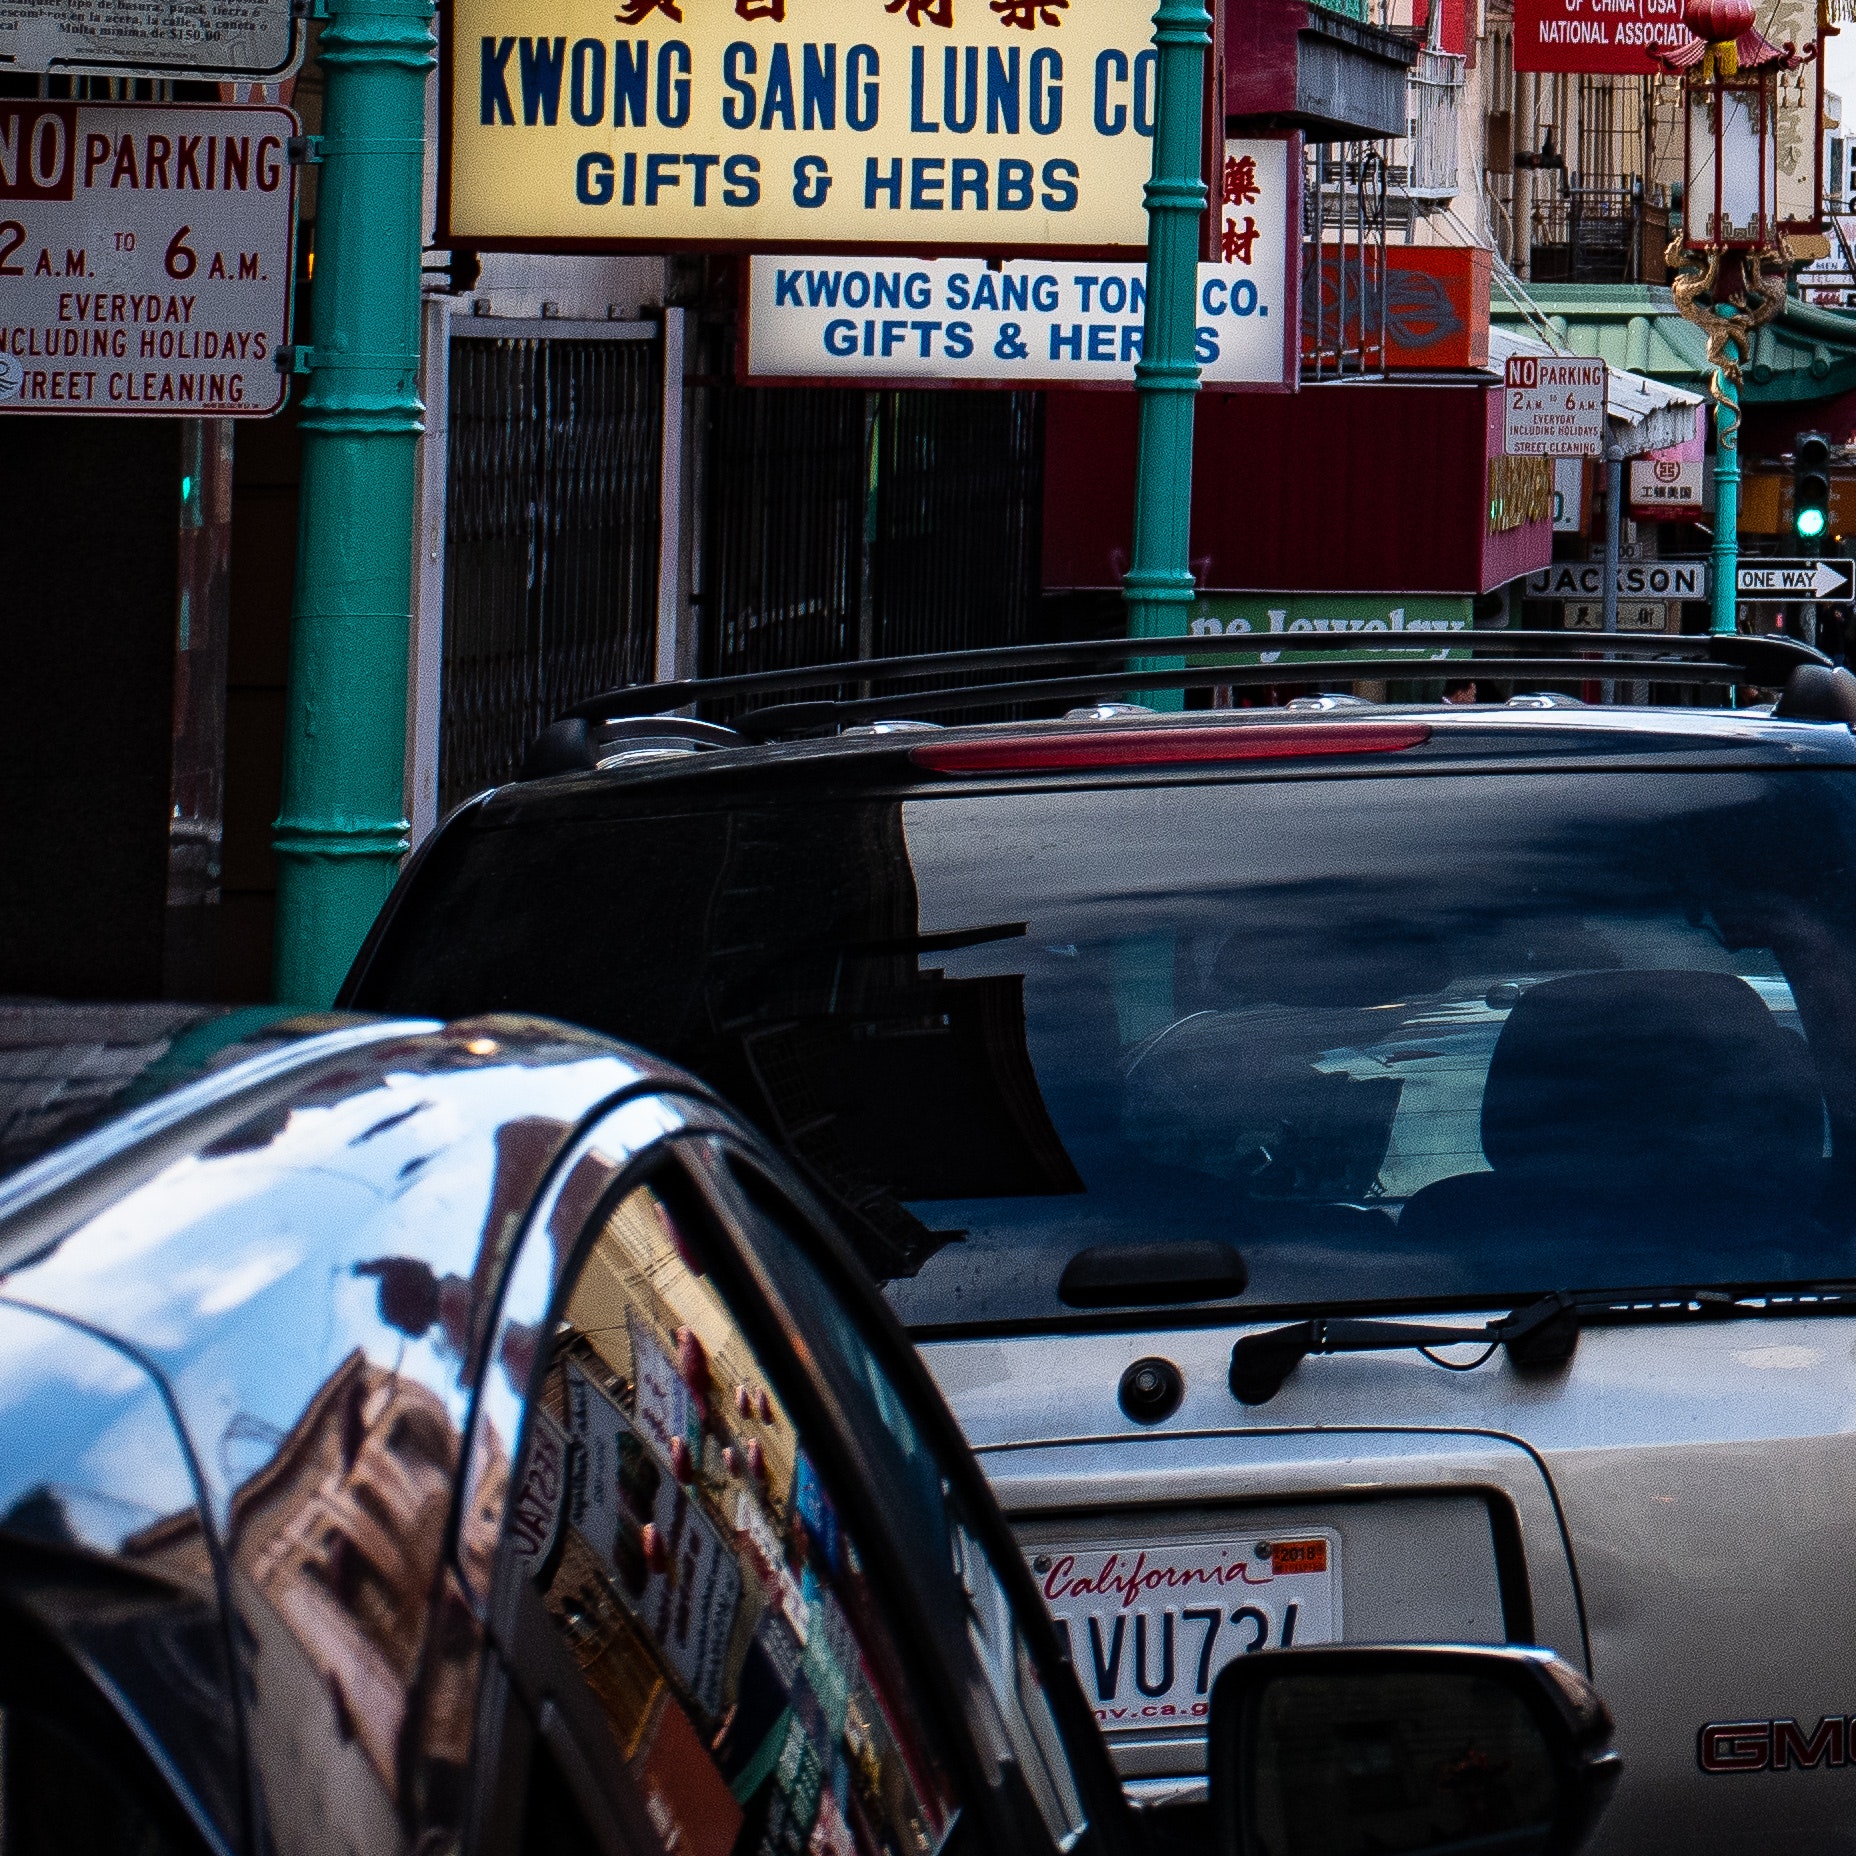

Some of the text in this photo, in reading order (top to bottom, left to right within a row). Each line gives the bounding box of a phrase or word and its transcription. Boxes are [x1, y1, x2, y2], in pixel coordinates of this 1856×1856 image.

[1540, 21, 1696, 45] NATIONAL ASSOCIATI
[481, 37, 691, 127] KWONG
[723, 43, 879, 130] SANG
[911, 46, 1062, 134] LUNG
[85, 135, 279, 190] PARKING
[577, 153, 1078, 210] GIFTS & HERBS
[36, 250, 95, 276] A.M.
[116, 233, 135, 251] TO
[165, 227, 196, 279] 6
[210, 253, 269, 279] A.M.
[776, 271, 1268, 316] KWONG SANG CO.
[59, 294, 193, 322] EVERYDAY
[140, 331, 266, 358] HOLIDAYS
[824, 320, 1219, 365] GIFTS & HERS
[1509, 360, 1600, 384] NO PARKING
[109, 373, 242, 402] CLEANING
[1513, 392, 1523, 410] 2
[1566, 394, 1575, 410] 6
[1511, 427, 1597, 435] INCLUDING HOLIDAYS
[1534, 415, 1575, 424] EVERYDAY
[1515, 443, 1595, 453] STREET CLEANING
[1743, 572, 1815, 587] ONE WAY
[1044, 1551, 1273, 1608] California
